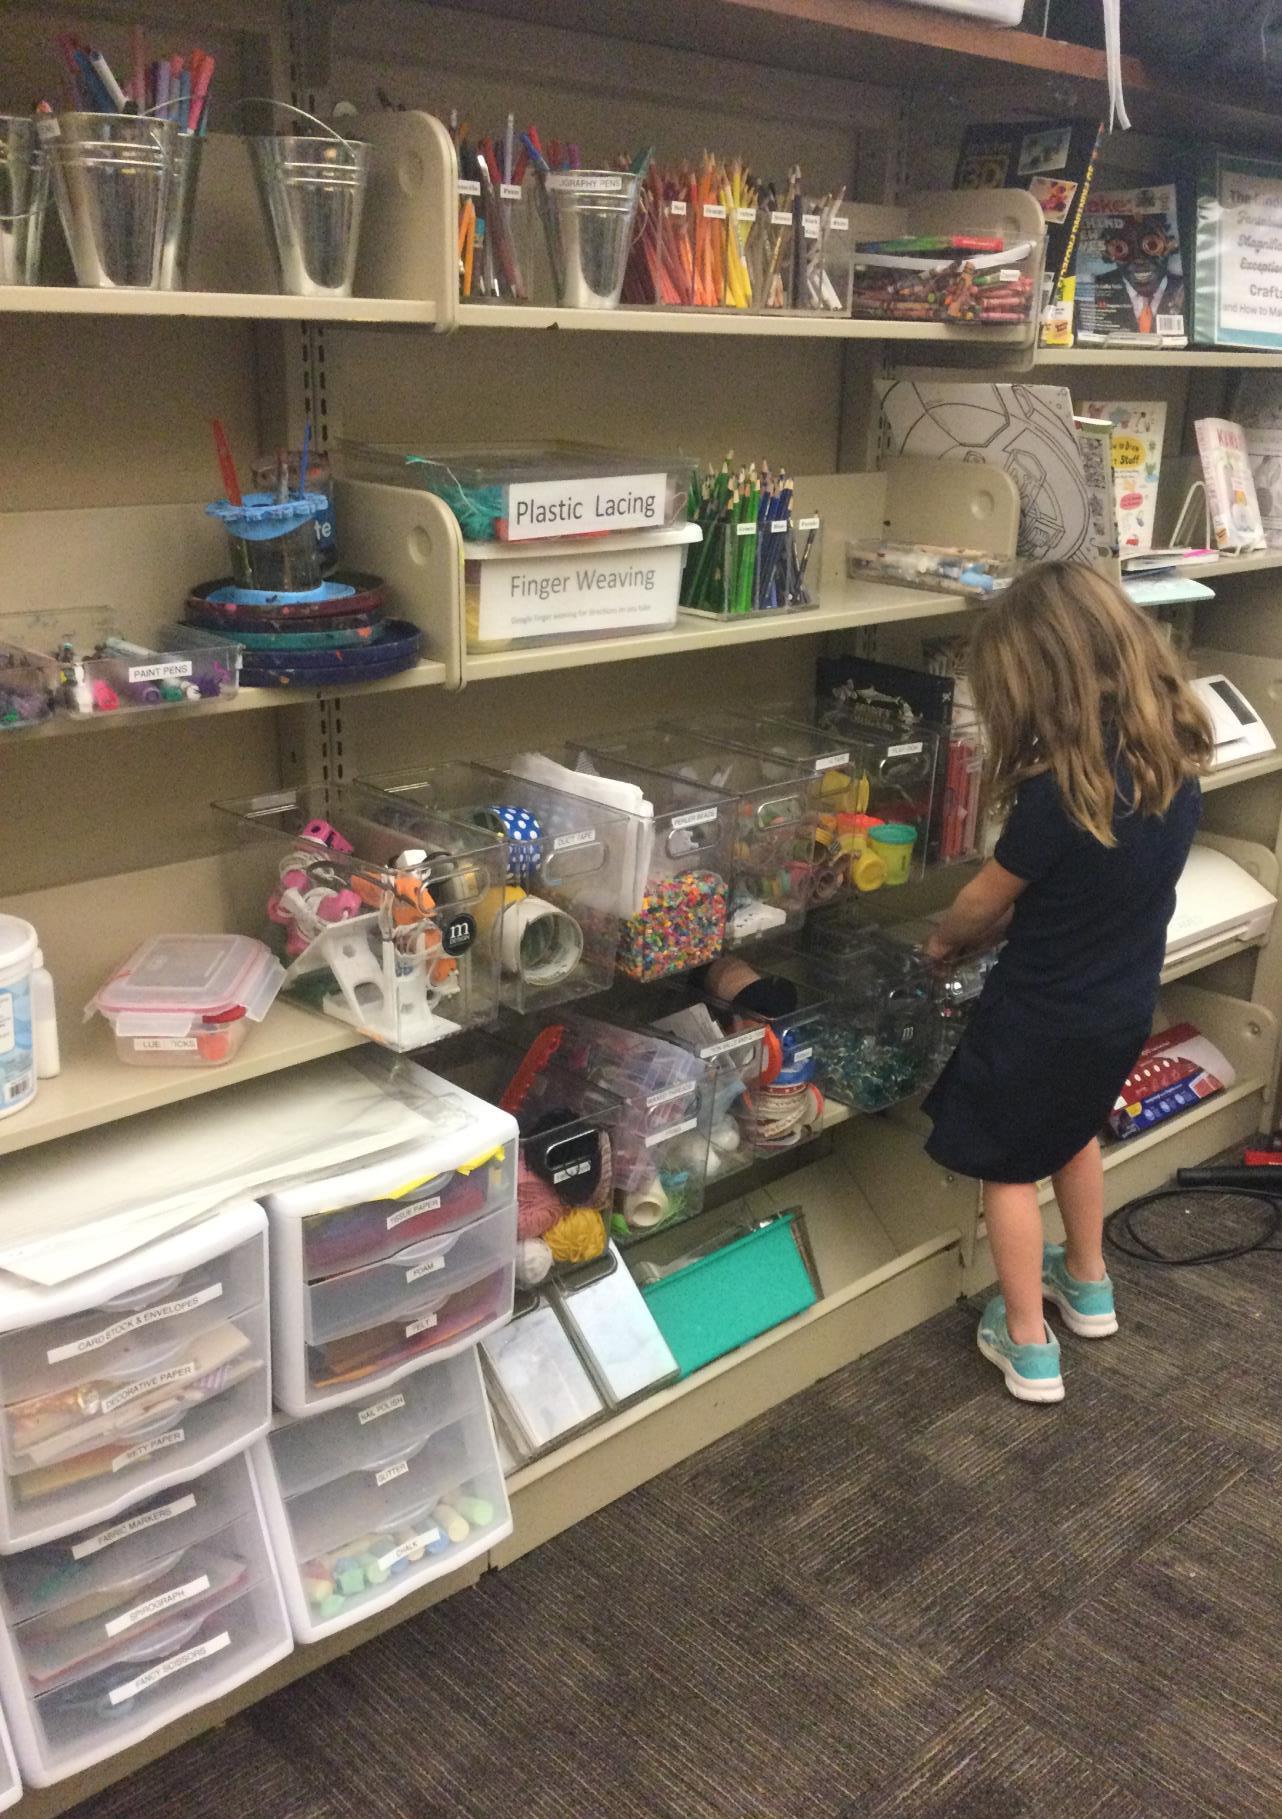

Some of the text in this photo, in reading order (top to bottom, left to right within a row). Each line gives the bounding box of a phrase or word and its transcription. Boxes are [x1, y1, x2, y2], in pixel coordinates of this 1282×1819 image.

[1120, 455, 1139, 465] Stuff
[516, 491, 656, 525] Plastic Lacing
[511, 566, 656, 600] Finger Weaving
[133, 664, 188, 679] PAINT PENS
[450, 922, 470, 938] m
[413, 1199, 439, 1212] PAPER
[413, 1262, 435, 1277] FOAM
[143, 1297, 199, 1322] ENVELOPES
[105, 1366, 192, 1409] DECORATIVE PAPER
[150, 1432, 181, 1447] PAPER
[377, 1463, 407, 1483] GLITTER
[128, 1507, 173, 1530] MARKERS
[395, 1540, 418, 1558] CHALK
[128, 1589, 185, 1622] SPIROGRAPH
[135, 1646, 207, 1690] FANCY SCISSORS
